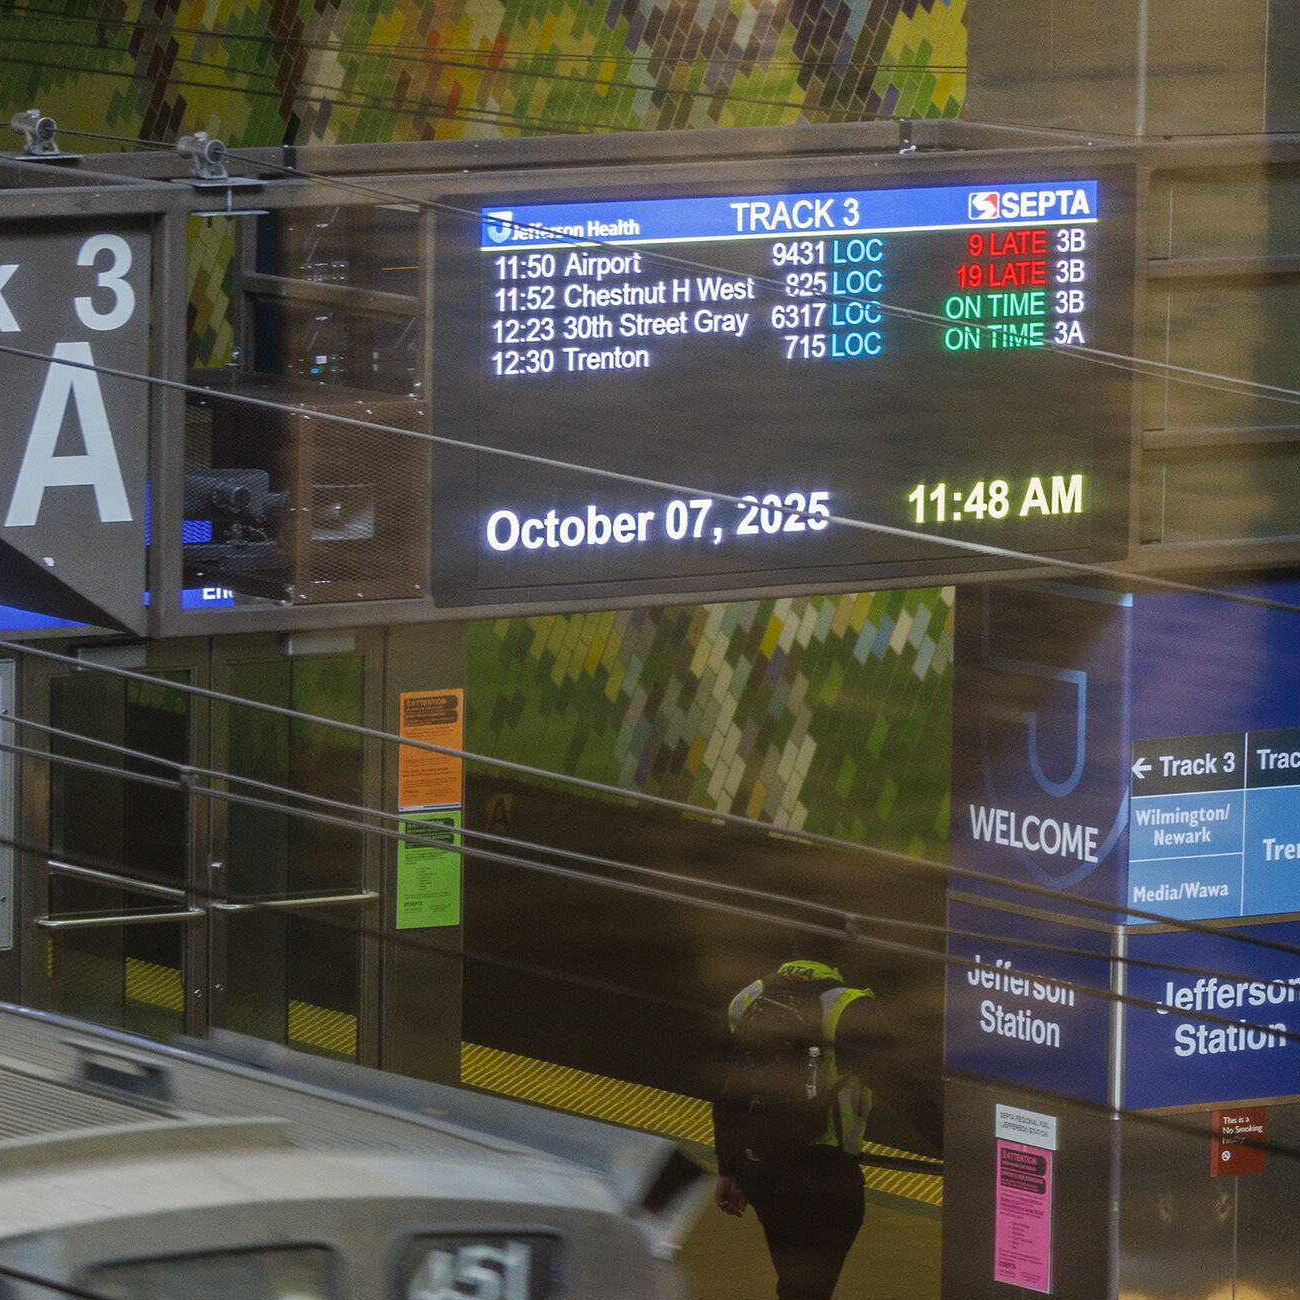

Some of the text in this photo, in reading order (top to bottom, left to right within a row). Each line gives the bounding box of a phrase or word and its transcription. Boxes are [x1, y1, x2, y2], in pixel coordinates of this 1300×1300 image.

[730, 198, 860, 231] TRACK 3
[1002, 190, 1090, 218] SEPTA
[511, 223, 583, 241] Jefferson
[588, 219, 640, 237] Health
[969, 228, 1085, 256] 9 LATE 3B
[495, 238, 883, 280] 11:50 Airport 9431 LOC
[956, 259, 1085, 288] 19 LATE 3B
[75, 234, 135, 331] 3
[494, 269, 882, 311] 11:52 Chestnut H West 825 LOC
[945, 290, 1084, 319] ON TIME 3B
[492, 301, 882, 343] 12:23 30th Street Gray 6317 LOC
[945, 321, 1085, 350] ON TIME 3A
[492, 332, 882, 375] 12:30 Trenton 715 LOC
[4, 341, 133, 527] A
[908, 474, 1083, 523] 11:48 AM
[487, 491, 831, 553] October 07, 2025
[1159, 751, 1235, 778] Track 3
[1135, 803, 1231, 827] Wilmington/
[969, 803, 1098, 863] WELCOME
[1154, 827, 1211, 846] Newark
[1133, 882, 1229, 904] Media/Wawa
[968, 954, 1075, 1006] Jefferson
[980, 1000, 1060, 1047] Station
[1174, 1020, 1287, 1057] Station
[1223, 1116, 1237, 1124] This
[1235, 1125, 1263, 1134] Smoking
